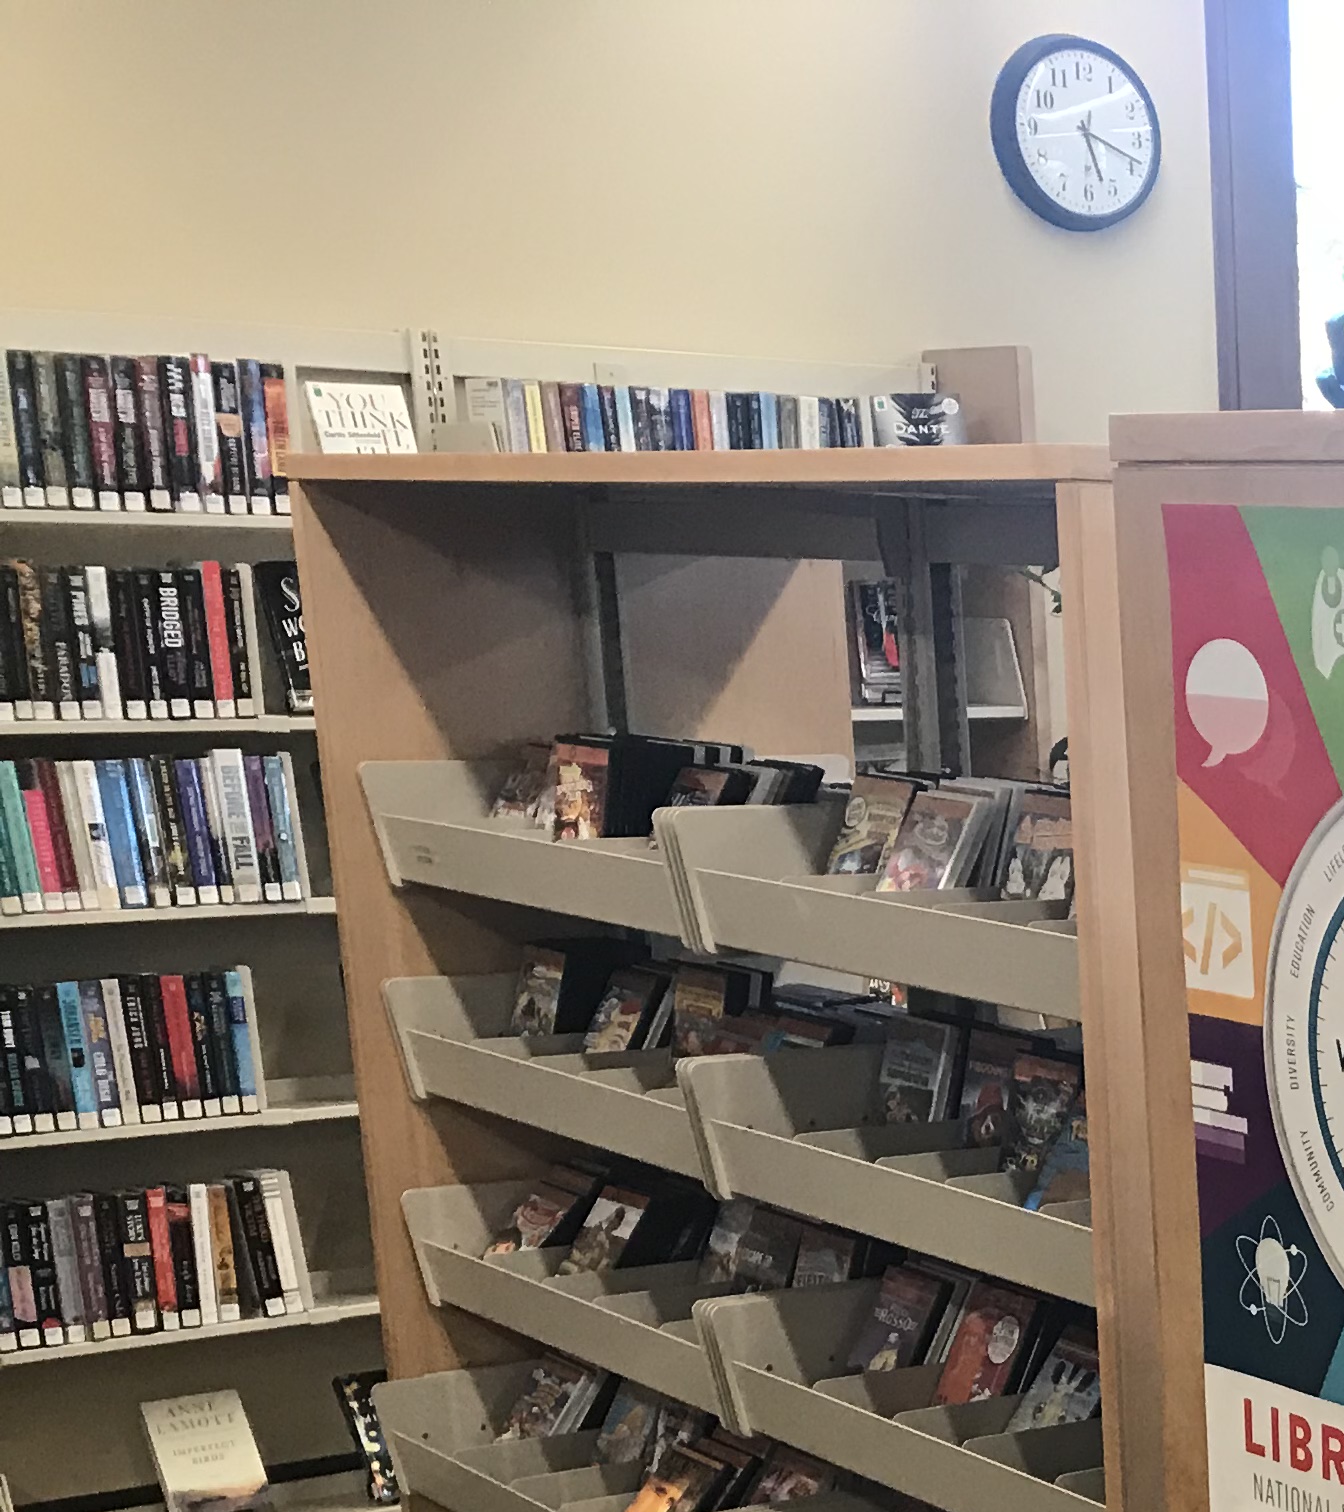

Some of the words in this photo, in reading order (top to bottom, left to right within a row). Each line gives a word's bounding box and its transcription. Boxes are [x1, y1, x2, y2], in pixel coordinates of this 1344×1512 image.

[1051, 67, 1068, 88] 11
[1075, 61, 1093, 82] 12
[1108, 75, 1113, 94] 1
[1036, 89, 1054, 109] 10
[1125, 102, 1135, 121] 2
[1027, 116, 1038, 137] 9
[1132, 131, 1142, 150] 3
[1036, 148, 1048, 165] 8
[1058, 172, 1069, 192] 7
[1107, 178, 1117, 198] 5
[1083, 183, 1095, 202] 6
[318, 410, 408, 429] THINK
[894, 422, 949, 435] DANTE
[158, 586, 182, 648] BRIDGED
[231, 835, 254, 870] FALL
[1290, 904, 1316, 978] EDUCATION
[1286, 1014, 1299, 1090] DIVERSITY
[1300, 1130, 1335, 1211] COMMUNITY
[166, 1400, 213, 1419] ANNE
[157, 1411, 235, 1436] LAMOTT
